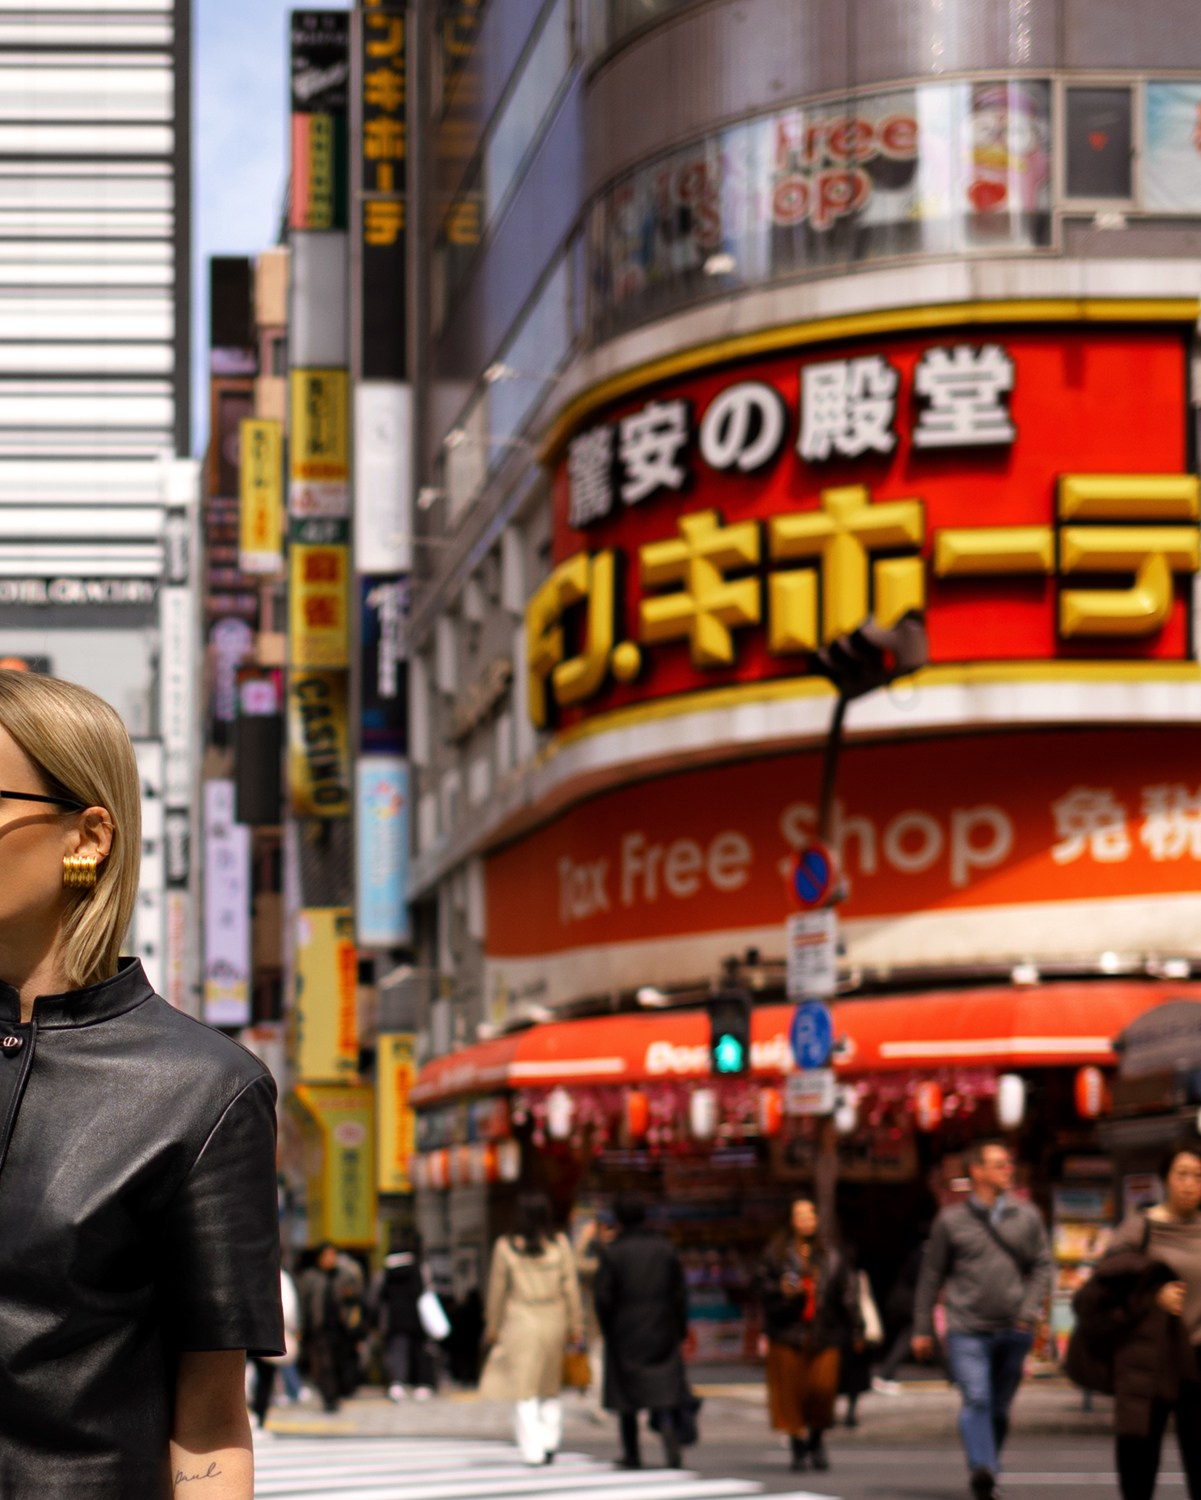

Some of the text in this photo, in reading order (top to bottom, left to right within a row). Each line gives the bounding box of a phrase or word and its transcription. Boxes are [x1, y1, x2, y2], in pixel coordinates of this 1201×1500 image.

[295, 678, 346, 806] CASINO
[622, 828, 752, 908] Free
[778, 797, 1014, 886] Shop
